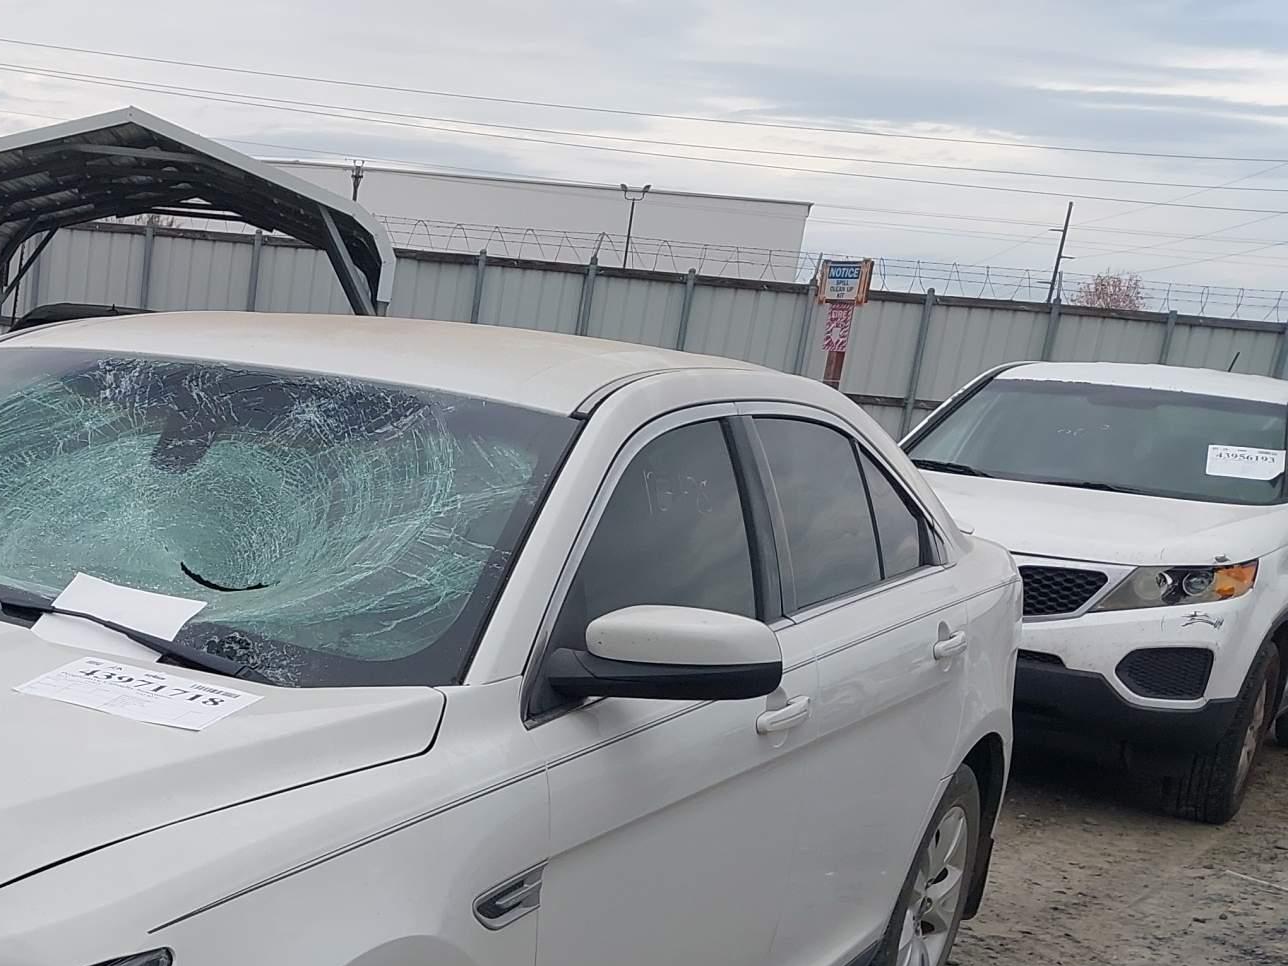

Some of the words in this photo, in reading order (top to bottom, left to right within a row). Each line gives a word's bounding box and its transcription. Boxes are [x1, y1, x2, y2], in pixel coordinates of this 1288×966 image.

[829, 267, 859, 279] NOTICE
[1215, 452, 1276, 464] 43956193
[79, 669, 225, 706] 43971718
